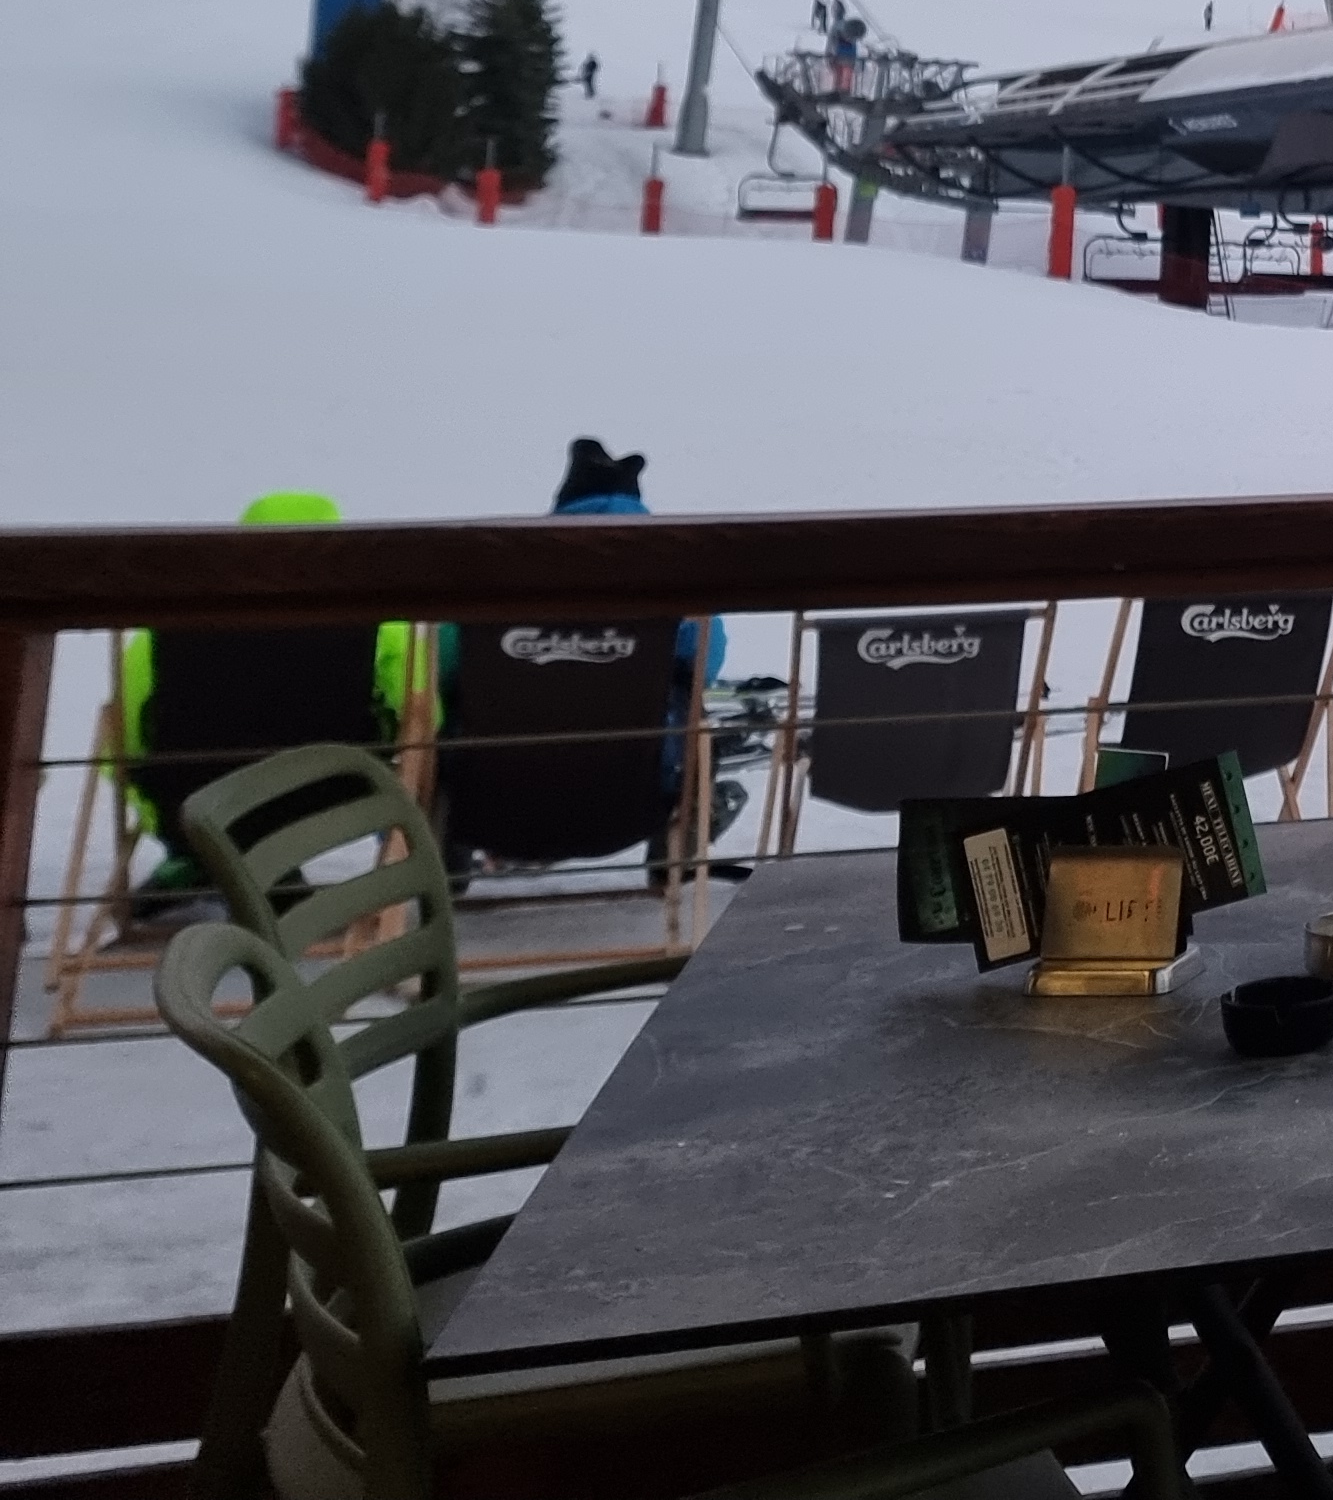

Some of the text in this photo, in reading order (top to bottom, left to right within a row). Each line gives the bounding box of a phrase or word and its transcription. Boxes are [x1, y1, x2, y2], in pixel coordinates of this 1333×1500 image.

[1181, 604, 1295, 643] Carlsberg
[501, 627, 635, 665] Carlsberg
[857, 624, 981, 670] Carlsberg
